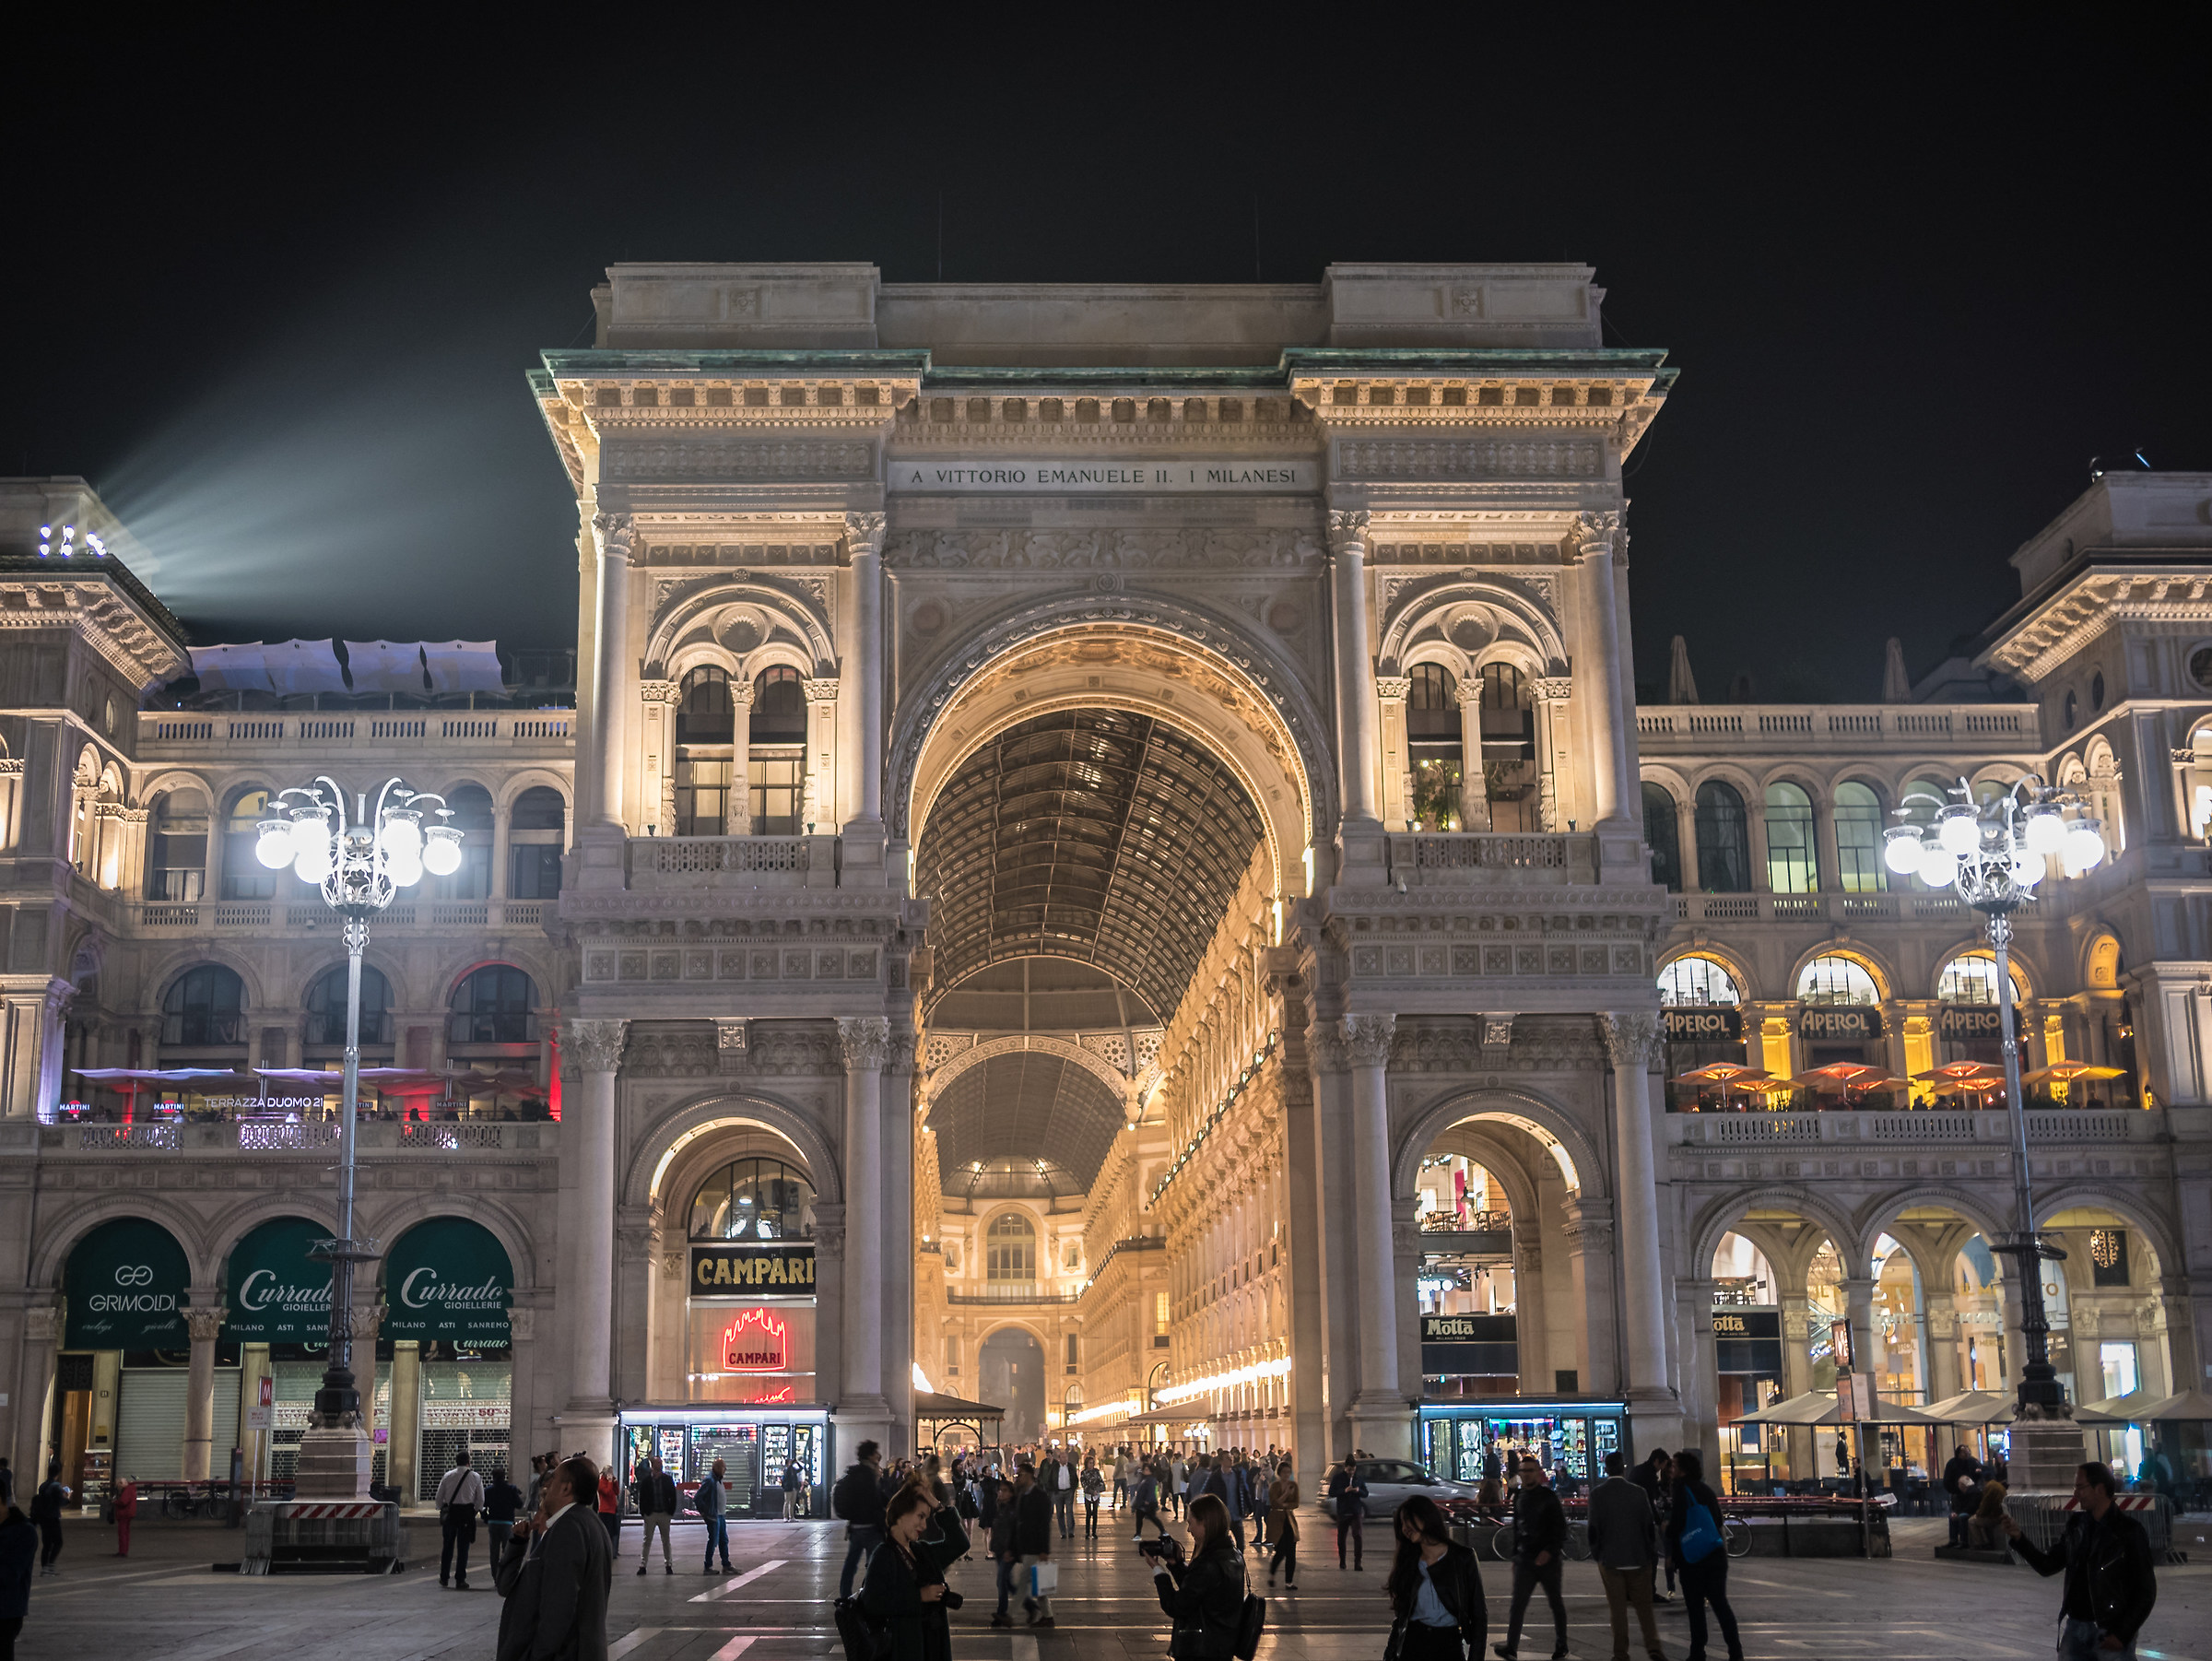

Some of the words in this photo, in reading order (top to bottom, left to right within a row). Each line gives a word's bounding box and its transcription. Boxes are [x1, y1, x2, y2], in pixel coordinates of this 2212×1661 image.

[912, 469, 924, 483] A
[936, 469, 1026, 483] VITTORIO
[1038, 469, 1145, 483] EMANUELE
[1190, 469, 1194, 483] I
[1207, 469, 1296, 483] MILANESI
[1663, 1010, 1731, 1031] APEROL
[1800, 1009, 1870, 1031] APEROL
[1941, 1008, 2001, 1030] APERO
[204, 1097, 265, 1108] TERRAZZA
[266, 1097, 312, 1108] DUOMO
[312, 1097, 324, 1107] 21
[697, 1257, 815, 1286] CAMPARI
[240, 1269, 332, 1312] Currad
[401, 1267, 503, 1309] Currado
[89, 1294, 176, 1312] GRIMOLDI
[282, 1303, 332, 1312] GIOIELLER
[444, 1301, 501, 1310] GIOIELLERIE
[230, 1324, 265, 1332] MILANO
[276, 1324, 294, 1332] ASTI
[306, 1324, 329, 1332] SANR
[392, 1321, 426, 1329] MILANO
[439, 1321, 456, 1329] ASTI
[467, 1321, 510, 1329] SANREMO
[1426, 1318, 1475, 1336] Motta
[1712, 1314, 1746, 1332] otta
[728, 1352, 781, 1365] CAMPARI
[263, 1384, 271, 1400] M
